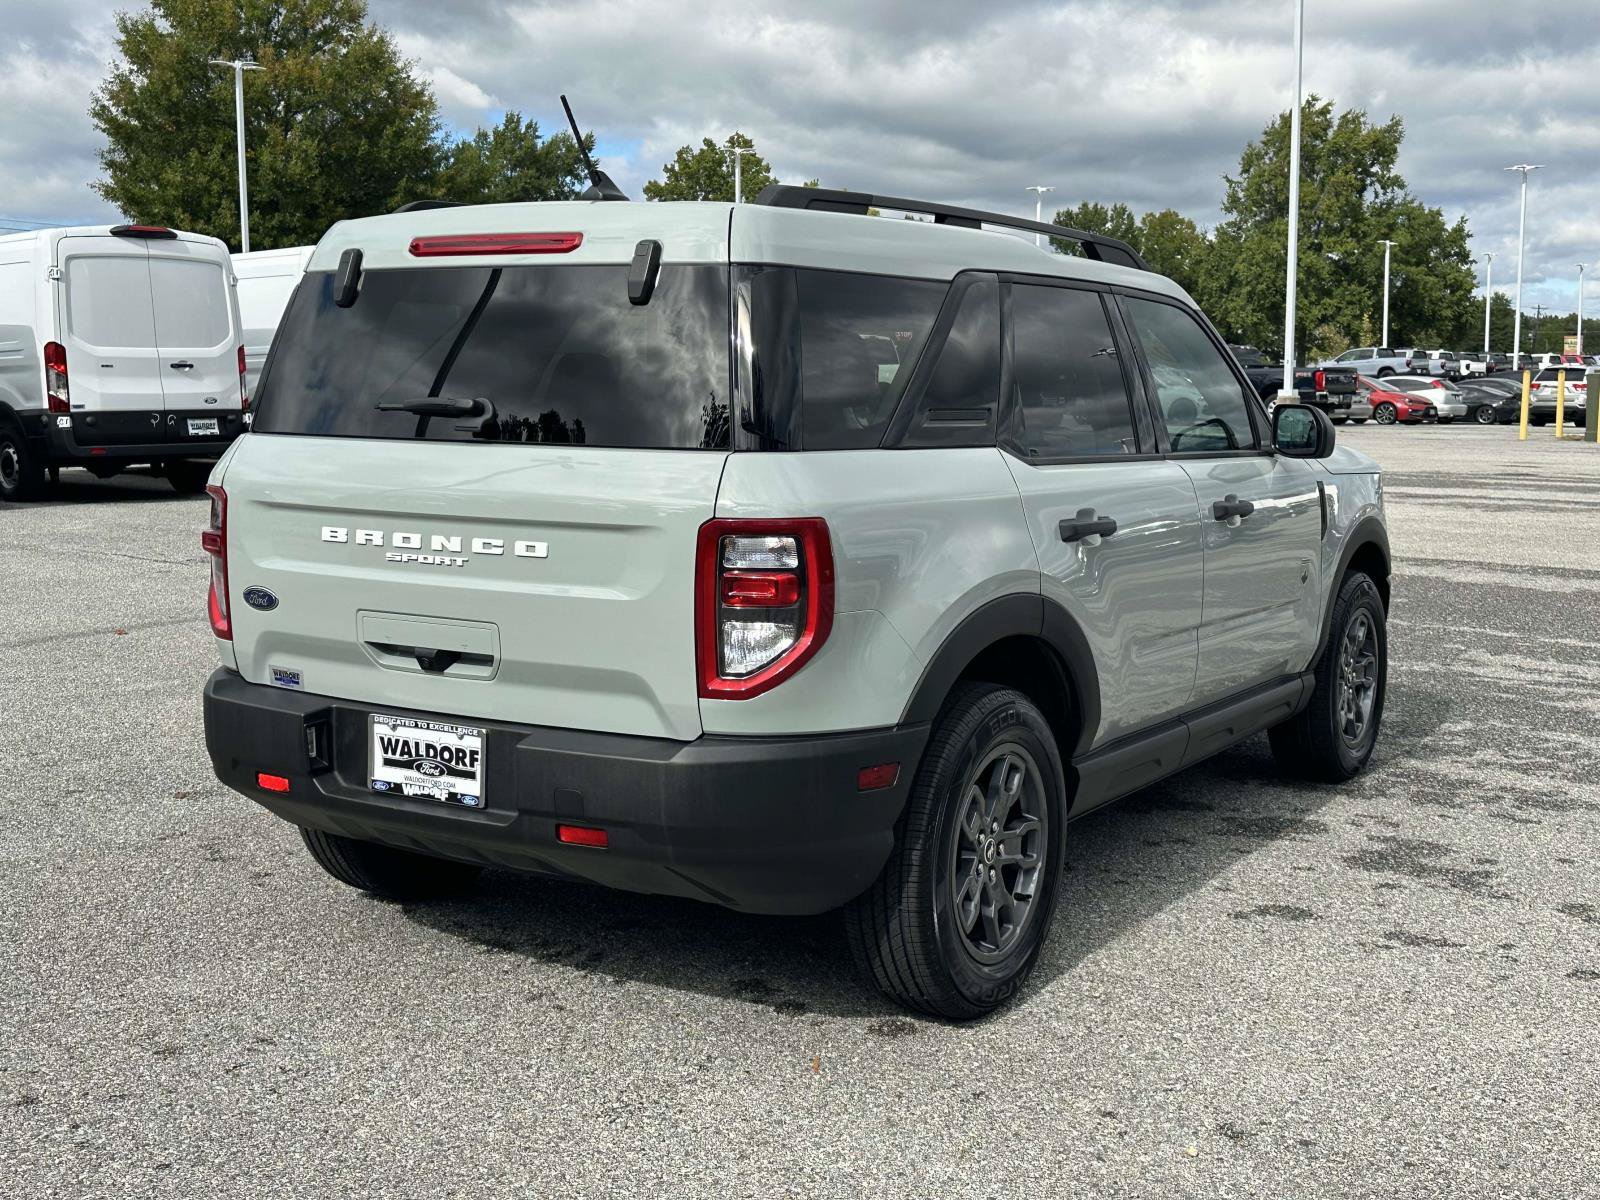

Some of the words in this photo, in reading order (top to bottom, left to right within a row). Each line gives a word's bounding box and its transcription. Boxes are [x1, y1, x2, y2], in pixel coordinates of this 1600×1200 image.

[321, 526, 548, 558] BRONCO
[385, 552, 469, 567] SPORT
[374, 716, 415, 727] DEDICATED
[429, 724, 478, 736] EXCELLENCE
[379, 736, 480, 768] WALDORF
[419, 762, 441, 776] Ford
